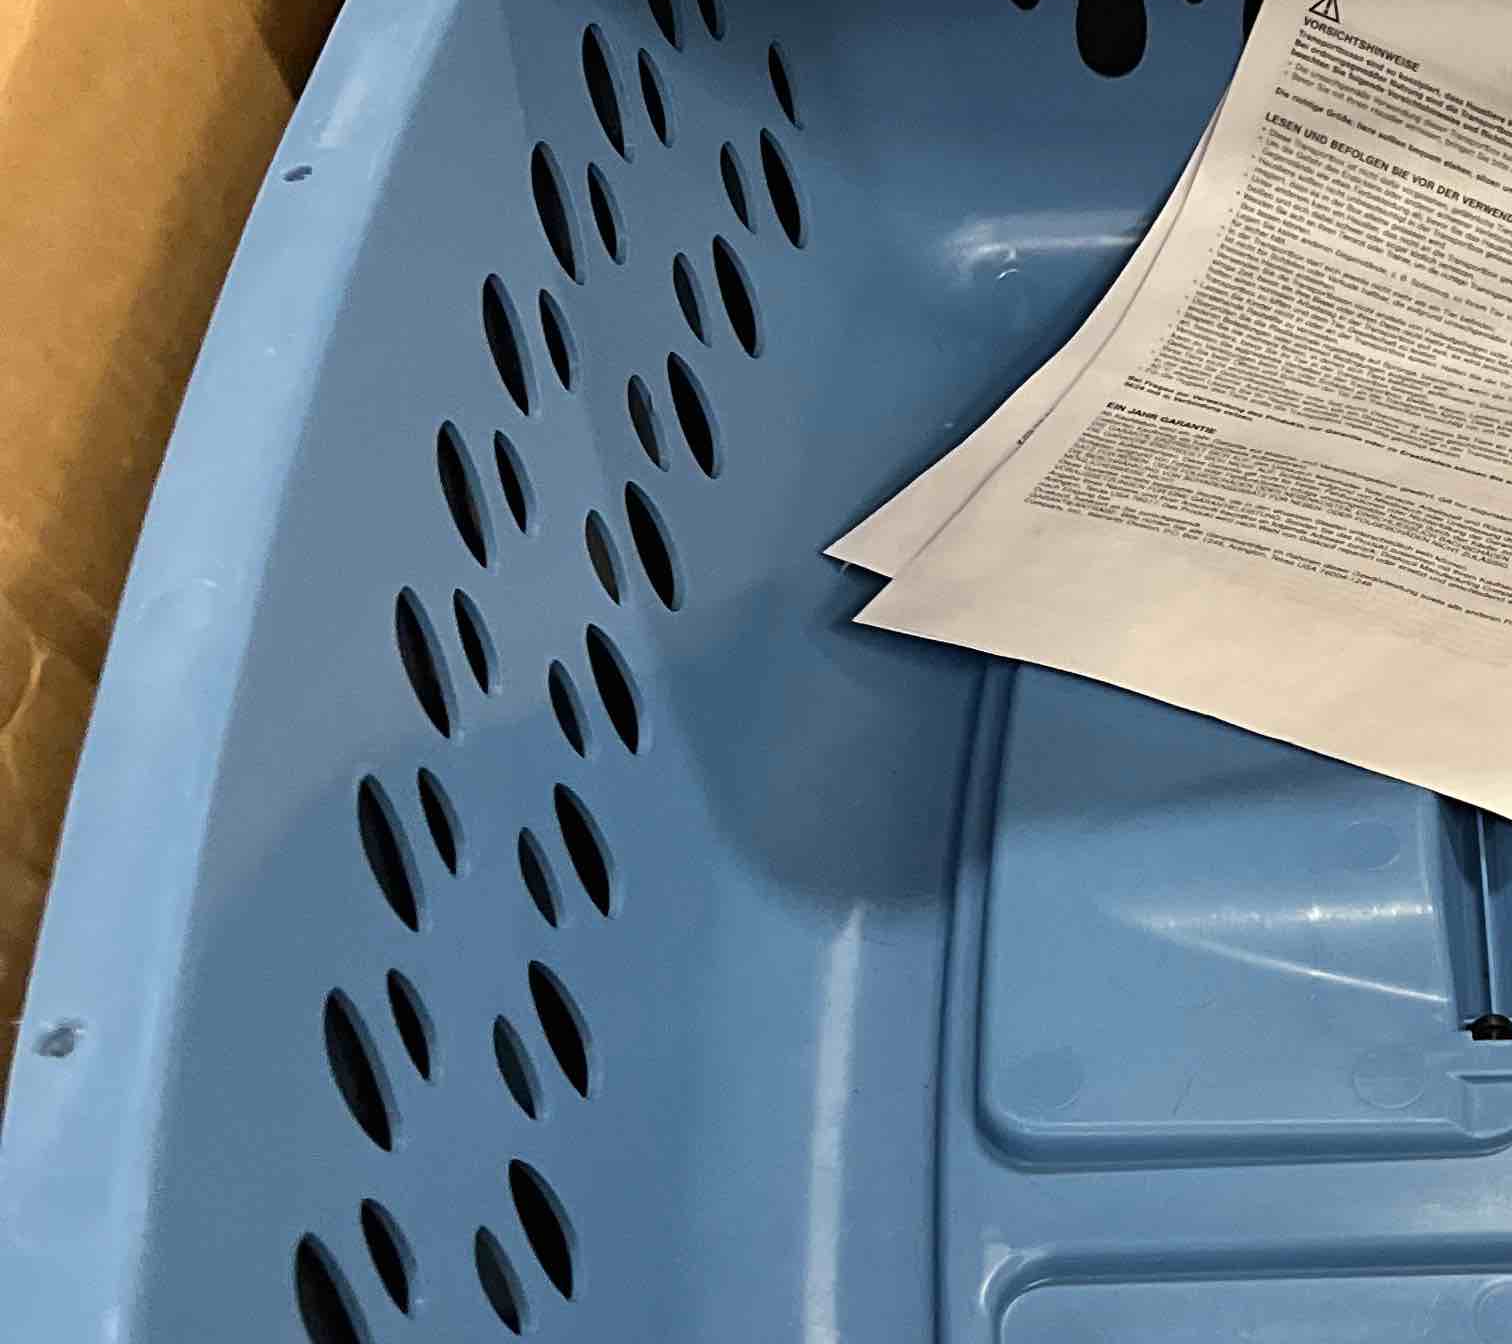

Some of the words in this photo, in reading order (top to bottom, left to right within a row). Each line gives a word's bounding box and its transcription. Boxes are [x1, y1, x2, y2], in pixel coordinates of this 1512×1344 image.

[1302, 15, 1421, 72] VORSICHTSHINWEISE
[1263, 111, 1302, 135] LESEN
[1302, 128, 1329, 146] UND
[1329, 139, 1390, 172] BEFOLGEN
[1390, 165, 1409, 180] SIE
[1410, 173, 1435, 191] VOR
[1436, 184, 1461, 201] DER
[1106, 401, 1127, 414] EIN
[1127, 405, 1158, 421] JAHR
[1160, 415, 1217, 435] GARANTIE
